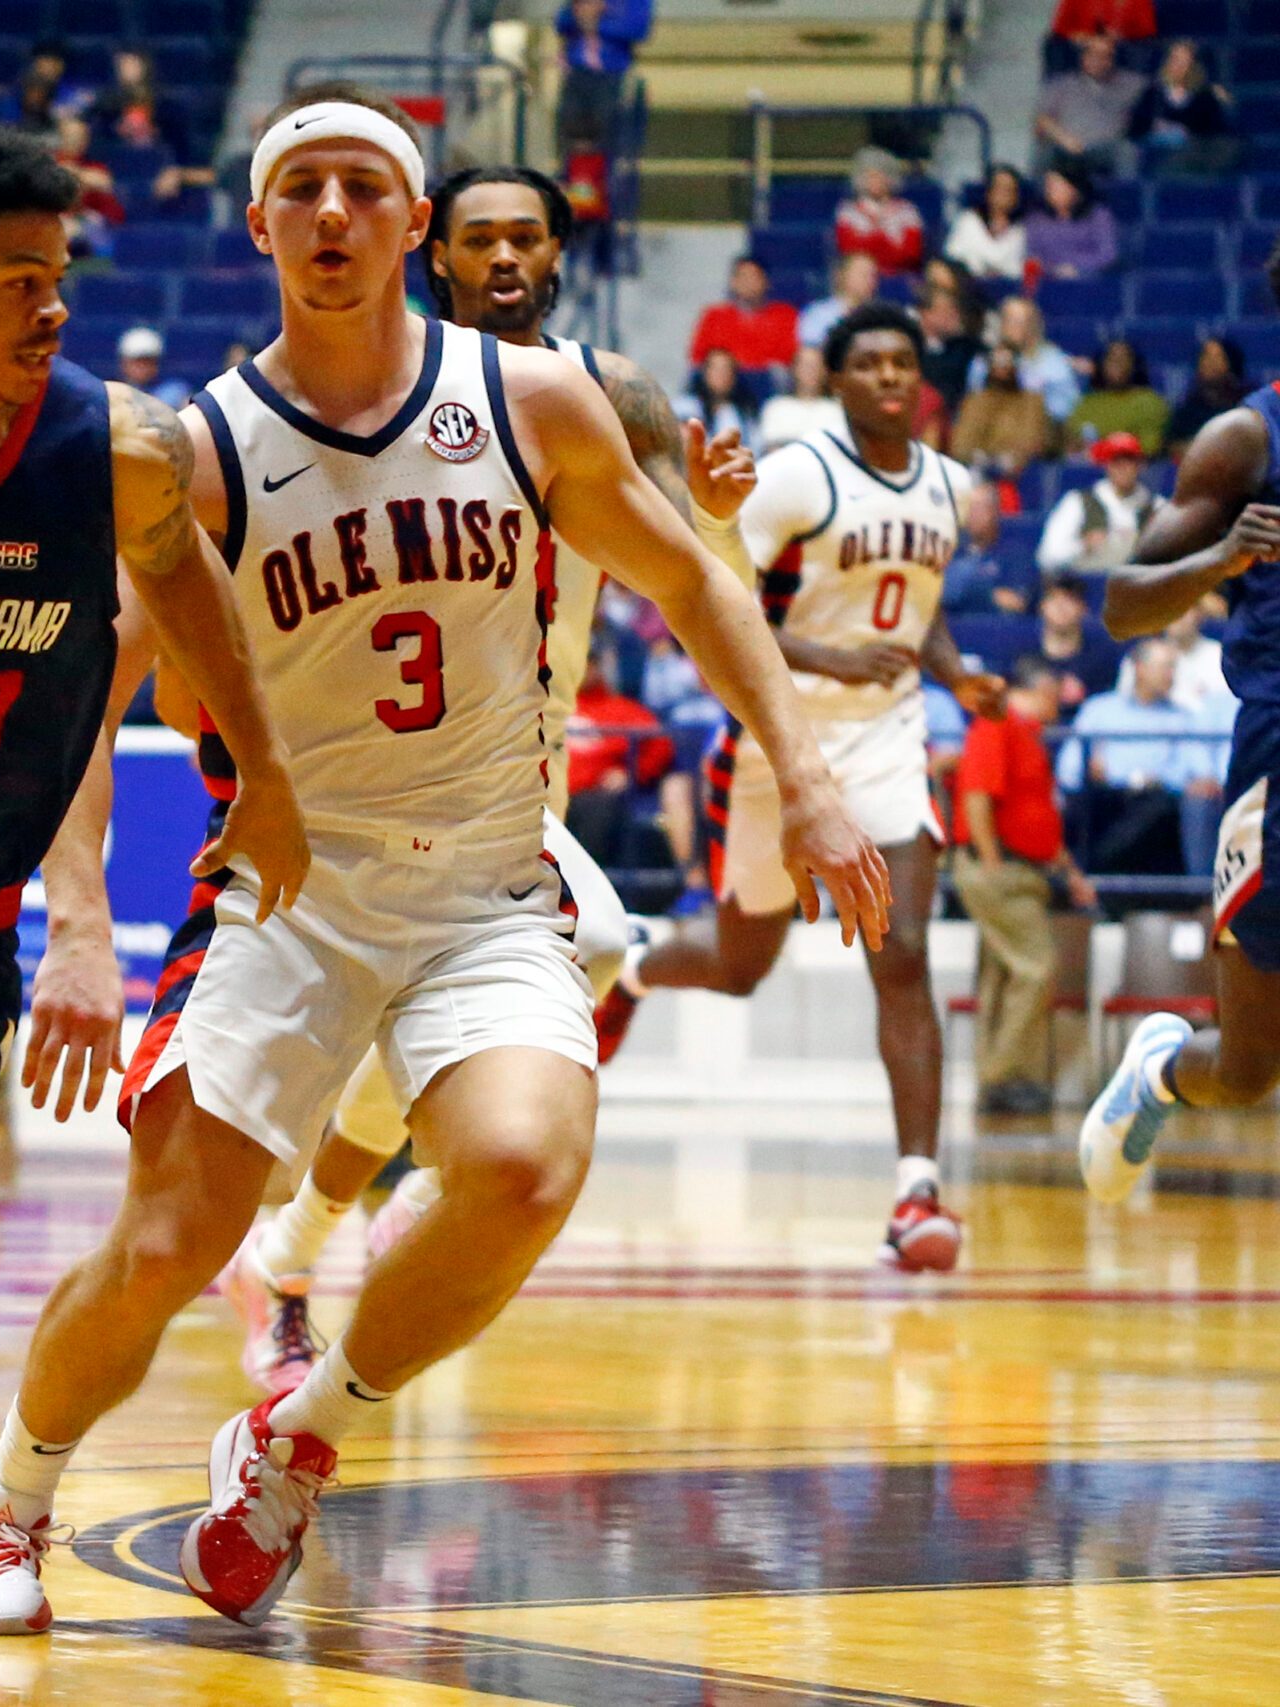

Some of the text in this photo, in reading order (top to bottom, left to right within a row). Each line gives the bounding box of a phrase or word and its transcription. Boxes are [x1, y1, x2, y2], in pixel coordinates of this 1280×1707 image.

[433, 404, 475, 447] SEC
[262, 508, 382, 632] OLE
[386, 498, 522, 590] MISS
[838, 520, 891, 571] OLE
[872, 571, 907, 631] 0
[371, 610, 447, 734] 3
